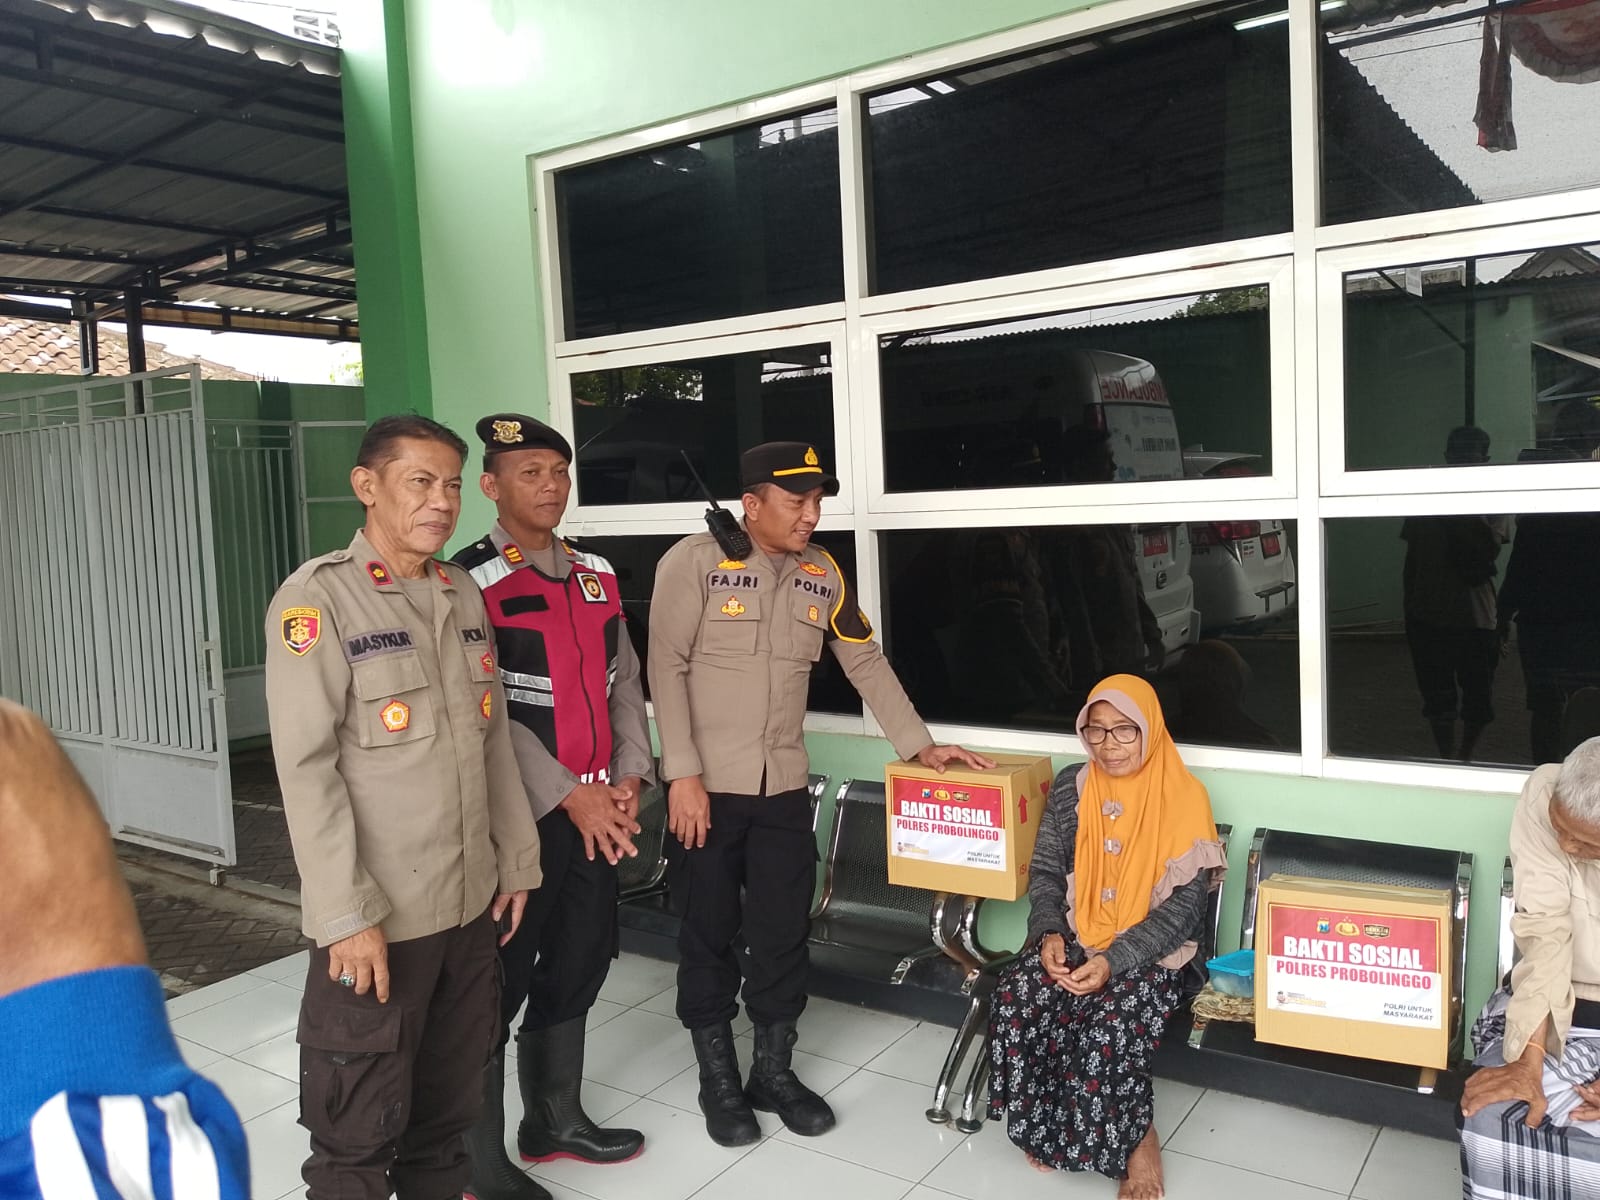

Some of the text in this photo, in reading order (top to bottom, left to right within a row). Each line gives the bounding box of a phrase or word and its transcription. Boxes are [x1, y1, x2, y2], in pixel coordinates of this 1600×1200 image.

[711, 574, 758, 588] FAJRI
[794, 578, 832, 599] POLRI
[348, 631, 412, 657] MASYKUR
[901, 800, 993, 827] BAKTI SOSIAL
[896, 818, 999, 841] POLRES PROBOLINGGO
[1283, 936, 1423, 970] BAKTI SOSIAL
[1276, 960, 1432, 990] POLRES PROBOLINGGO
[1383, 1002, 1433, 1013] POLRI UNTUK
[1383, 1010, 1434, 1021] MASYARAKAT
